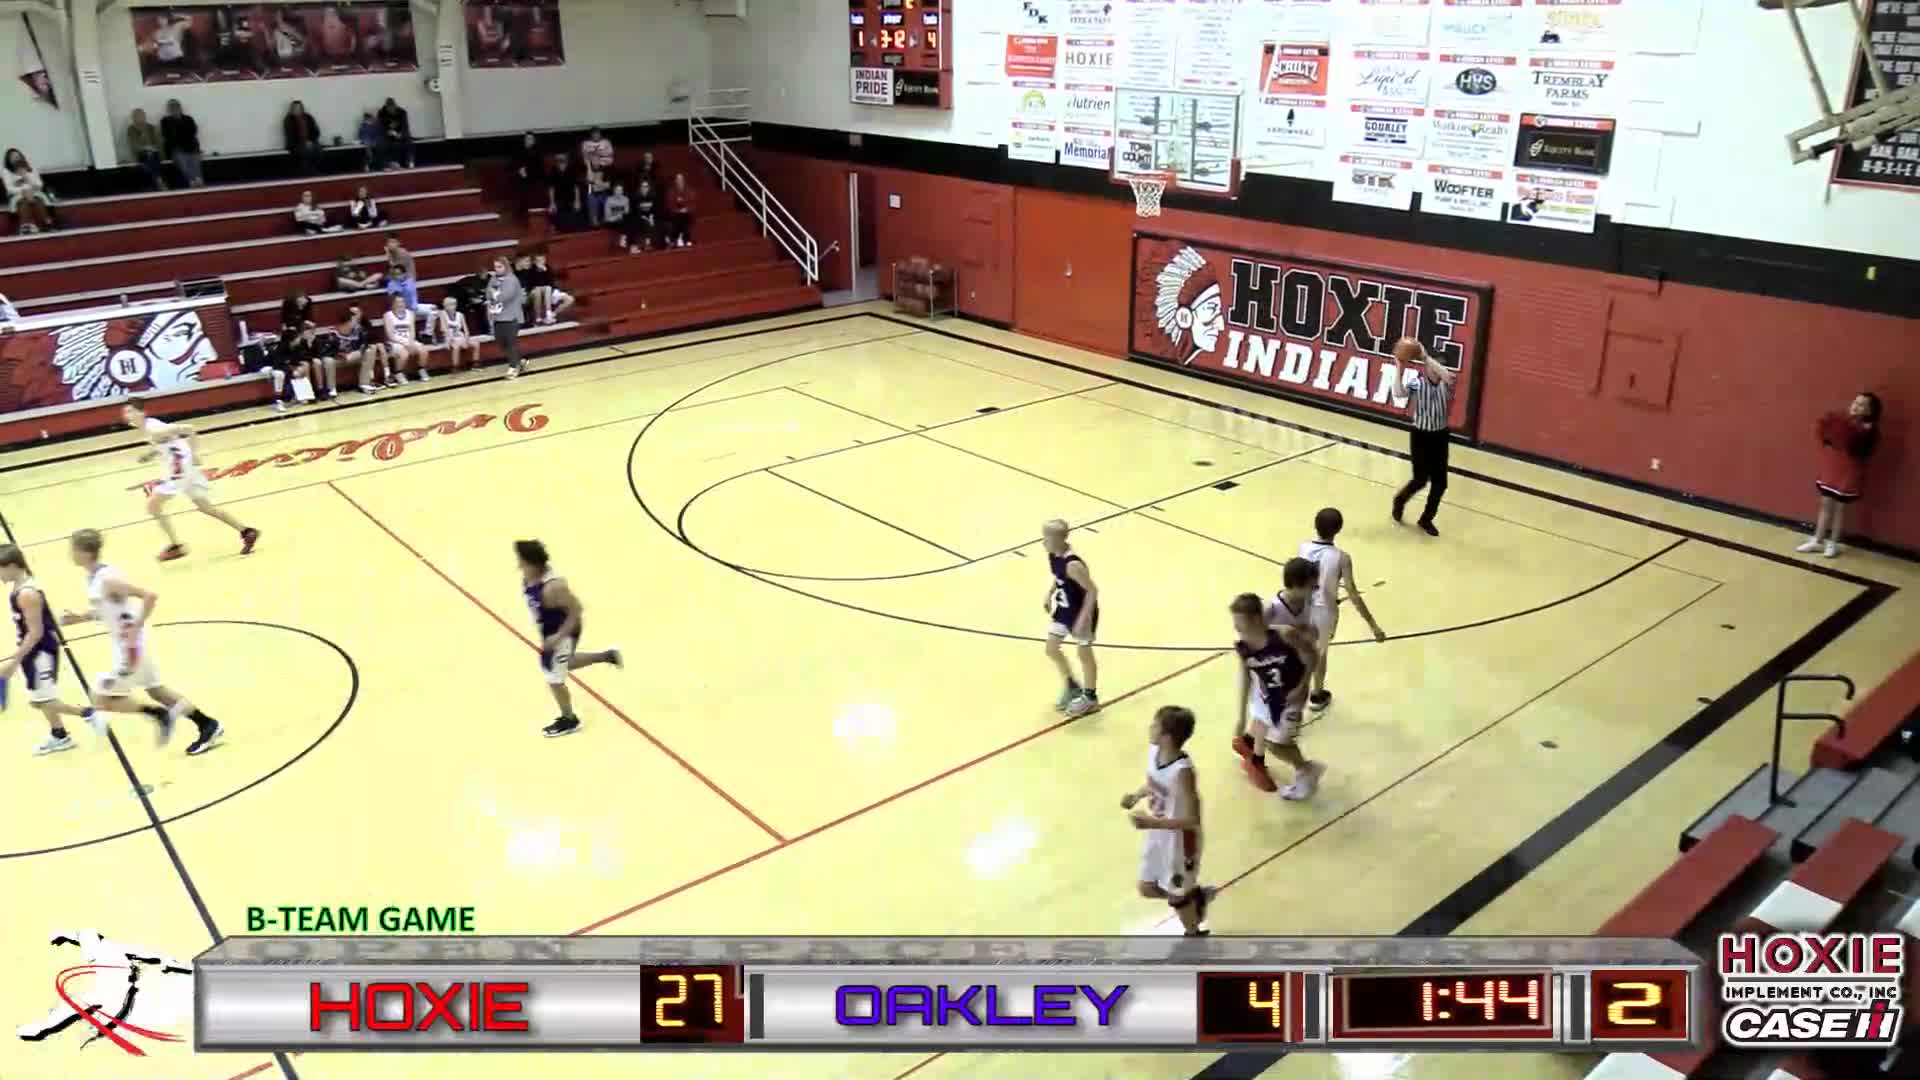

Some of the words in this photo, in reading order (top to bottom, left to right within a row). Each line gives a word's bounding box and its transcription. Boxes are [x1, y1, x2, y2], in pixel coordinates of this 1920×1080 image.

[1065, 51, 1113, 66] HOXIE
[855, 69, 888, 81] INDIAN
[1532, 71, 1608, 88] TREMBLAY
[855, 81, 888, 95] PRIDE
[1545, 87, 1590, 100] FARMS
[1365, 121, 1407, 133] GOURLEY
[1434, 178, 1495, 199] WOOFTER
[1227, 257, 1468, 372] HOXIE
[1221, 330, 1422, 409] INDIAN
